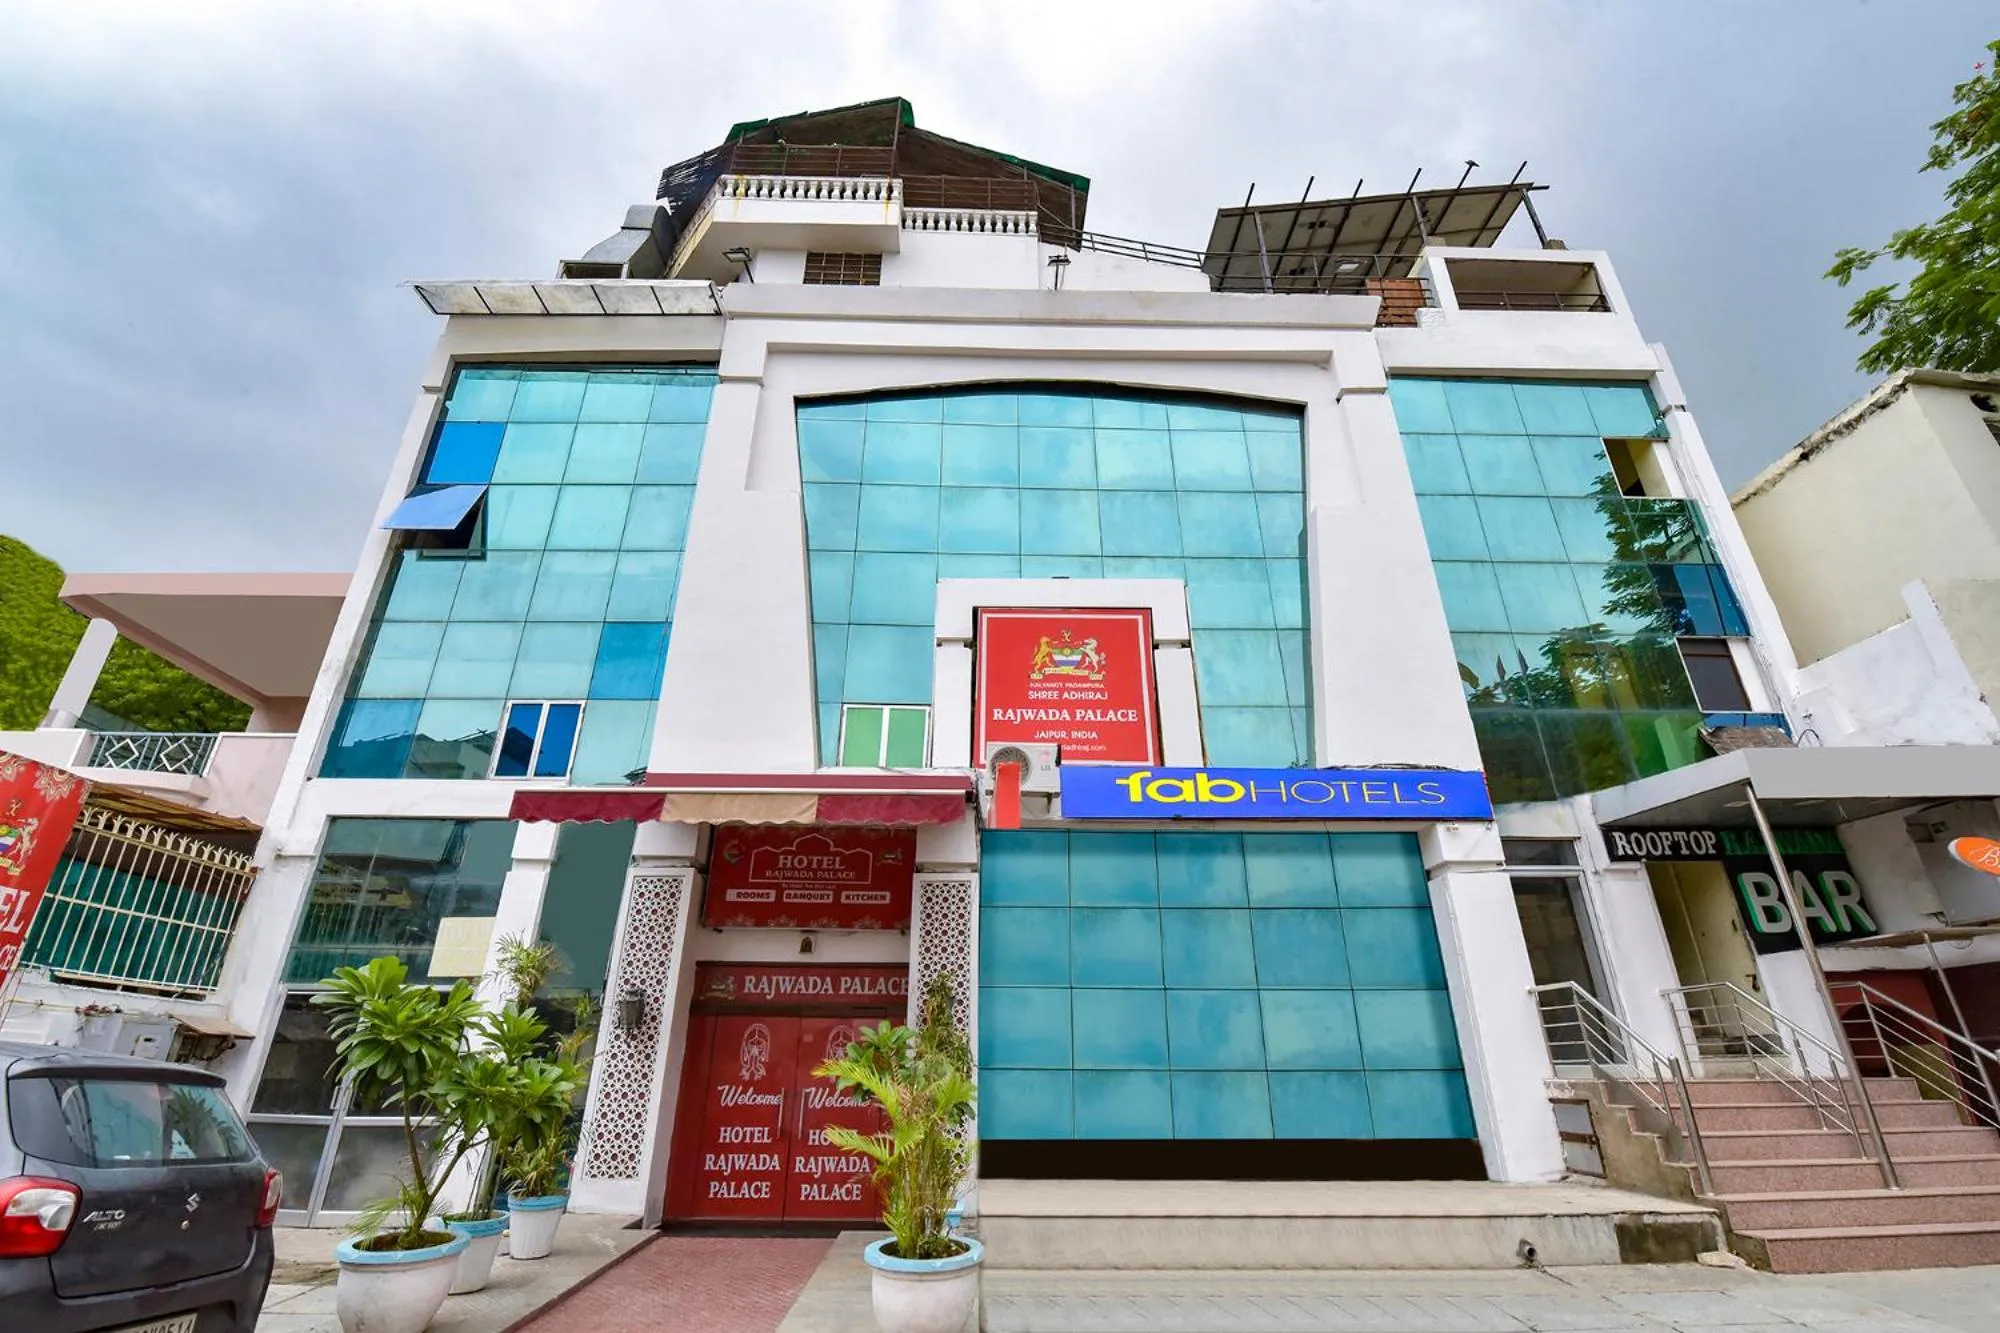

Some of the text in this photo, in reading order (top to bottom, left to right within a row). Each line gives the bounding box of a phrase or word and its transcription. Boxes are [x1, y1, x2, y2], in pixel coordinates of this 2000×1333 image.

[1028, 690, 1108, 700] SHREE ADHIRAJ
[992, 708, 1138, 724] RAJWADA PALACE
[1071, 731, 1098, 739] INDIA
[1613, 831, 1716, 857] ROOFTOP
[778, 854, 845, 869] HOTEL
[765, 869, 855, 881] RAJWADA PALACE
[736, 891, 771, 900] ROOMS
[844, 894, 887, 902] KITCHEN
[1737, 870, 1877, 934] BAR
[743, 975, 834, 999] RAJWADA
[717, 1084, 783, 1107] Welcome
[718, 1126, 773, 1144] HOTEL
[704, 1153, 781, 1176] RAJWADA
[794, 1156, 870, 1178] RAJWADA
[708, 1181, 771, 1199] PALACE
[800, 1184, 862, 1201] PALACE
[83, 1209, 126, 1223] ALTO
